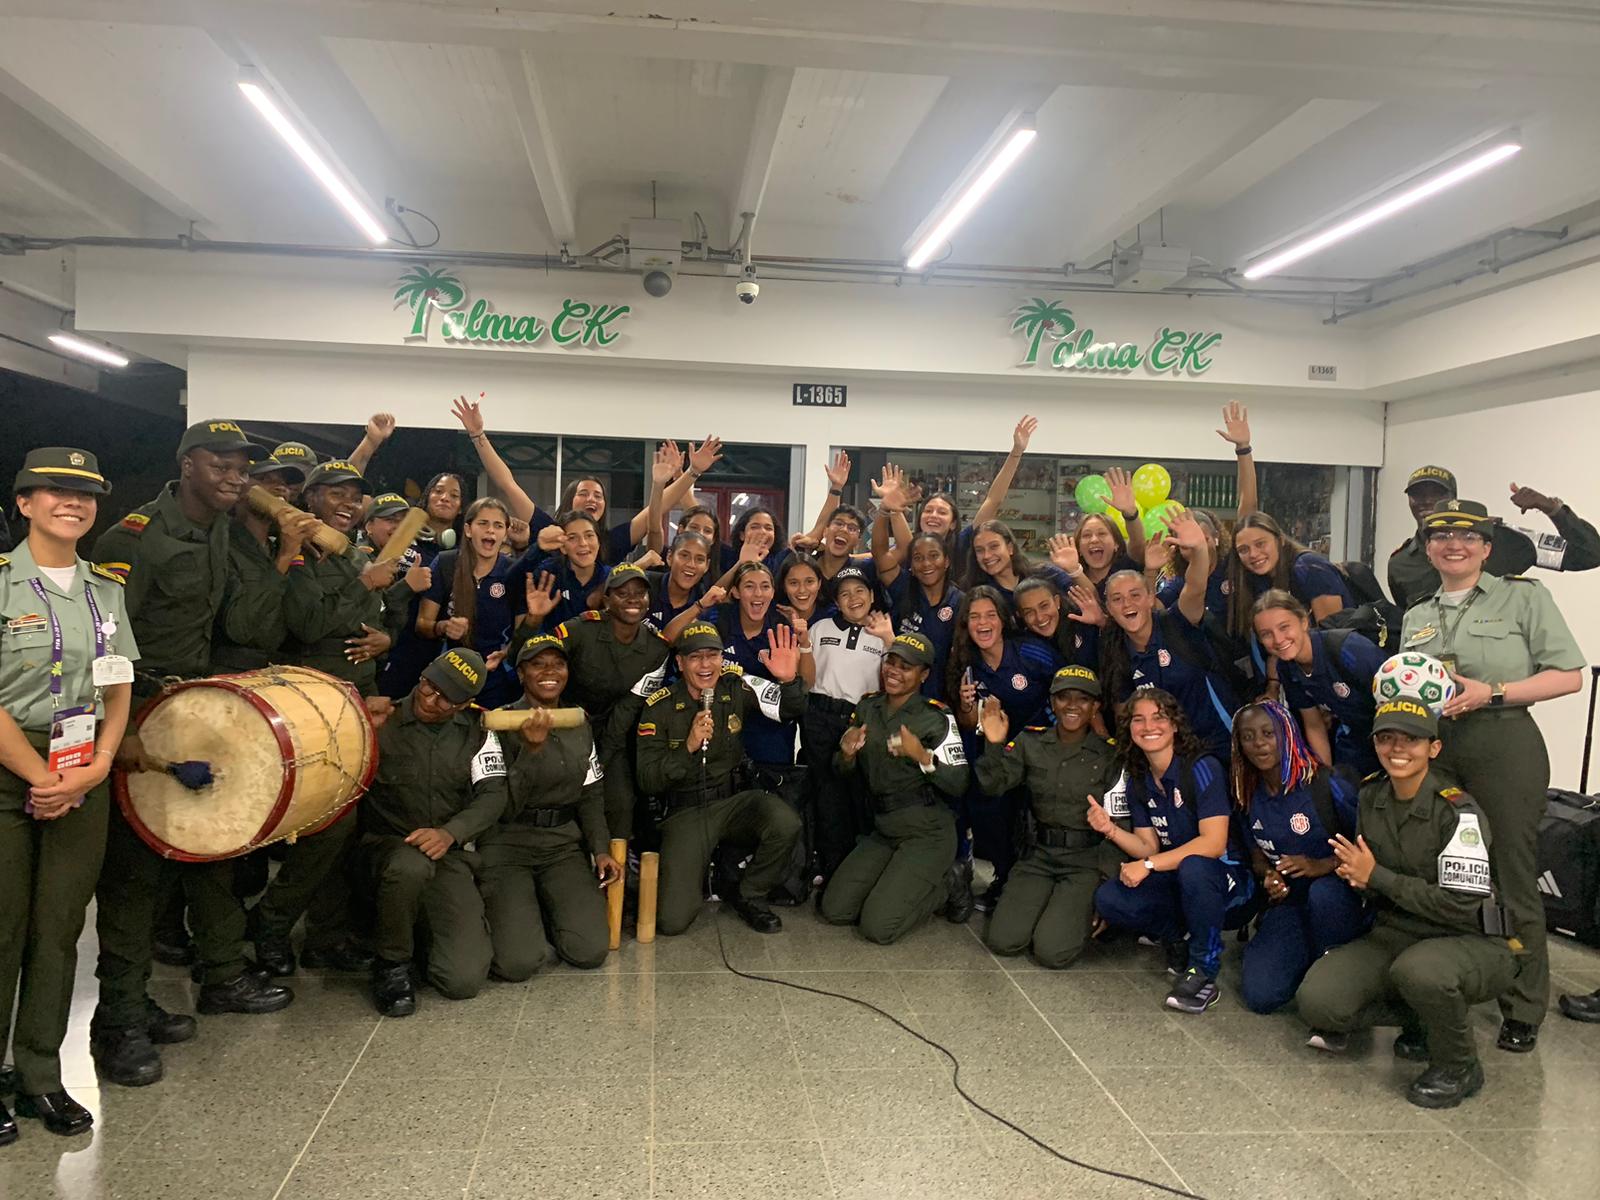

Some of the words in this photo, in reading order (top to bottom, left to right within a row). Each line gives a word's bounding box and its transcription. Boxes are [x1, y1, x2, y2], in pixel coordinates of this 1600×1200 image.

[394, 265, 543, 344] Palma
[550, 299, 630, 345] CK
[1011, 297, 1146, 370] Palma
[1148, 327, 1223, 371] CK
[796, 386, 843, 404] L-1365
[444, 651, 479, 685] POLICIA
